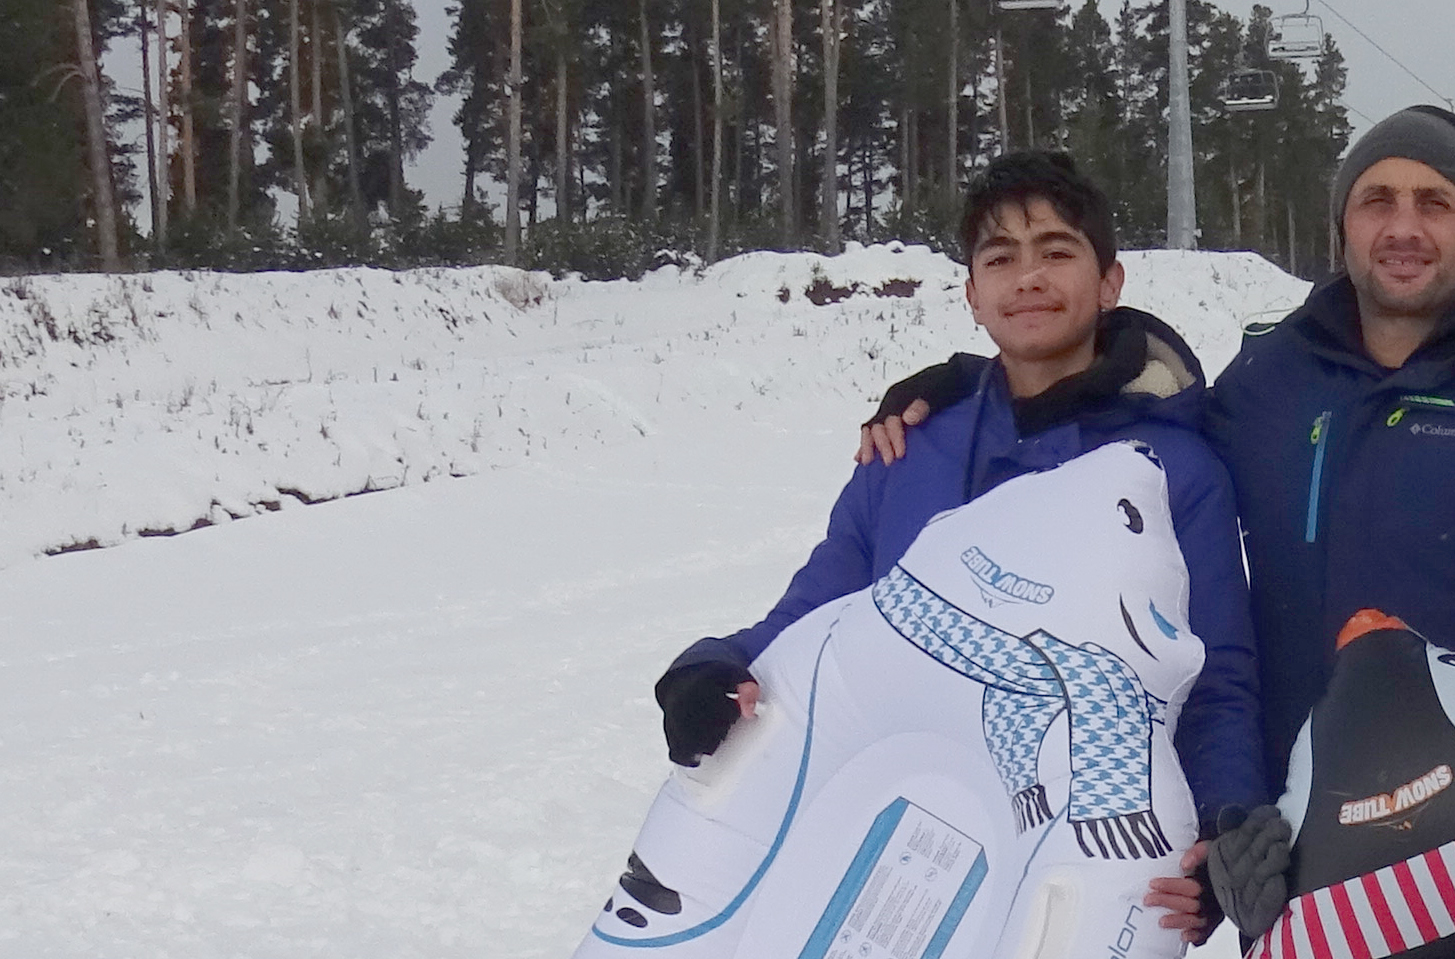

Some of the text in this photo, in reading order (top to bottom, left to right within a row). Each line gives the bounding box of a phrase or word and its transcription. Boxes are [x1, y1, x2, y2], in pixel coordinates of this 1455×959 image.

[961, 546, 1054, 604] SNOW TUBE
[1339, 764, 1453, 825] SNOW TUBE
